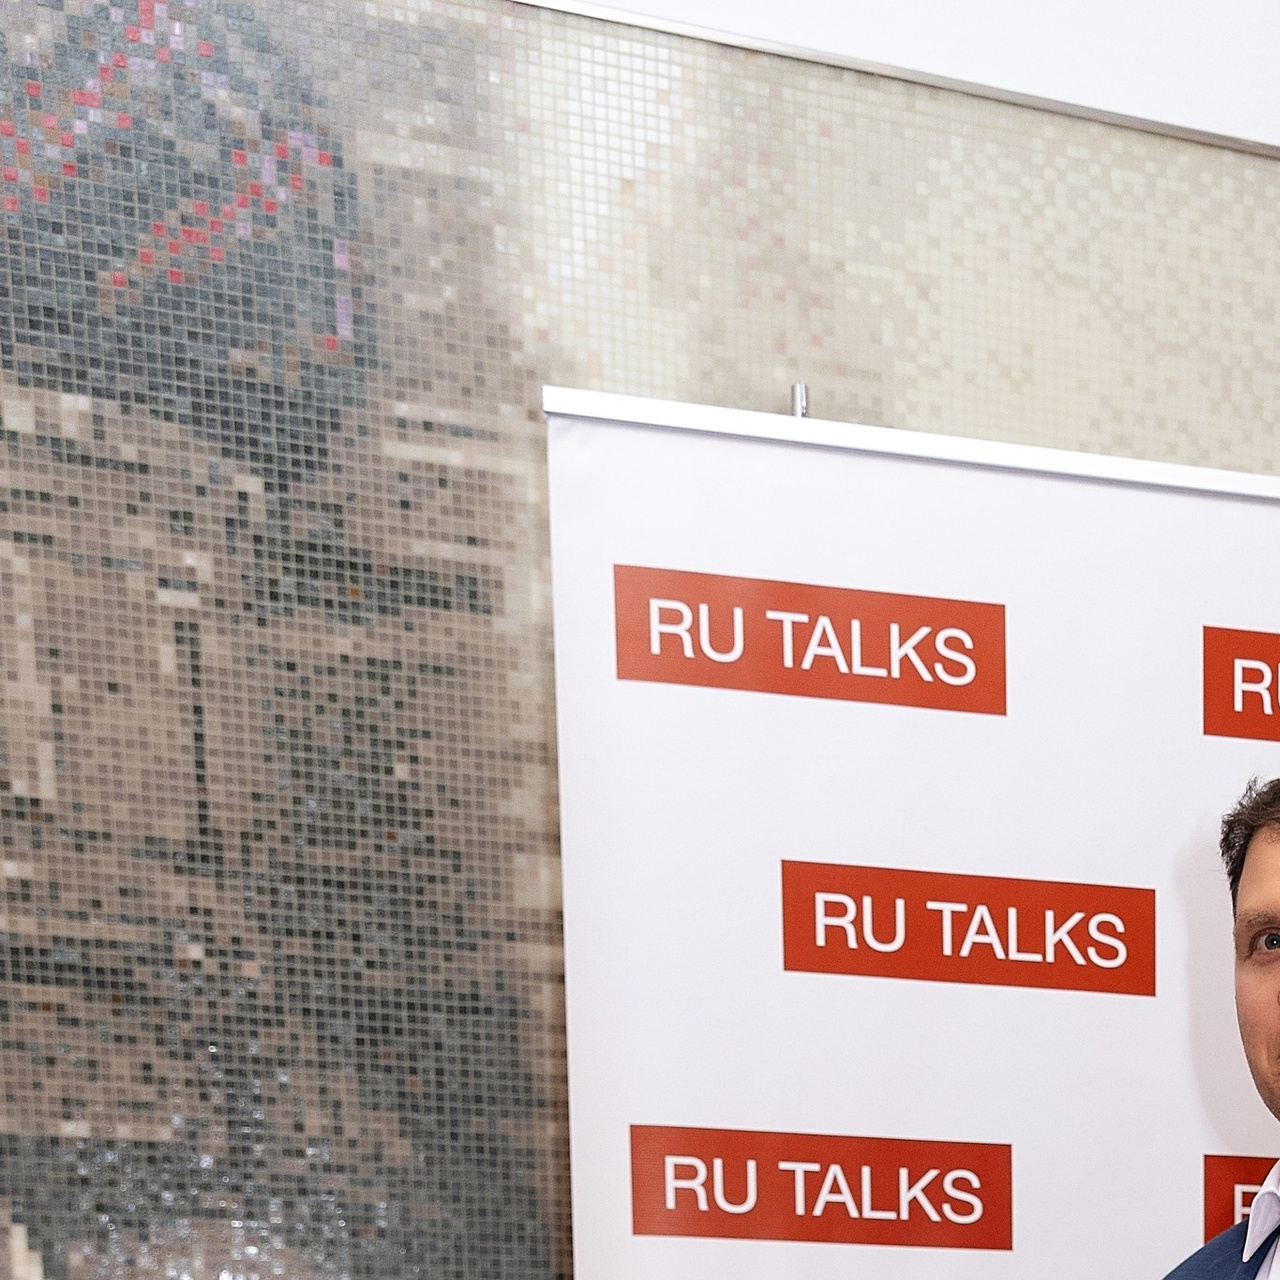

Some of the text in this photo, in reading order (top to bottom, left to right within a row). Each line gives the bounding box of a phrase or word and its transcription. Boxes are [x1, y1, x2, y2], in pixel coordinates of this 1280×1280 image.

[649, 597, 977, 686] RU TALKS
[814, 891, 1128, 969] RU TALKS
[663, 1154, 984, 1225] RU TALKS
